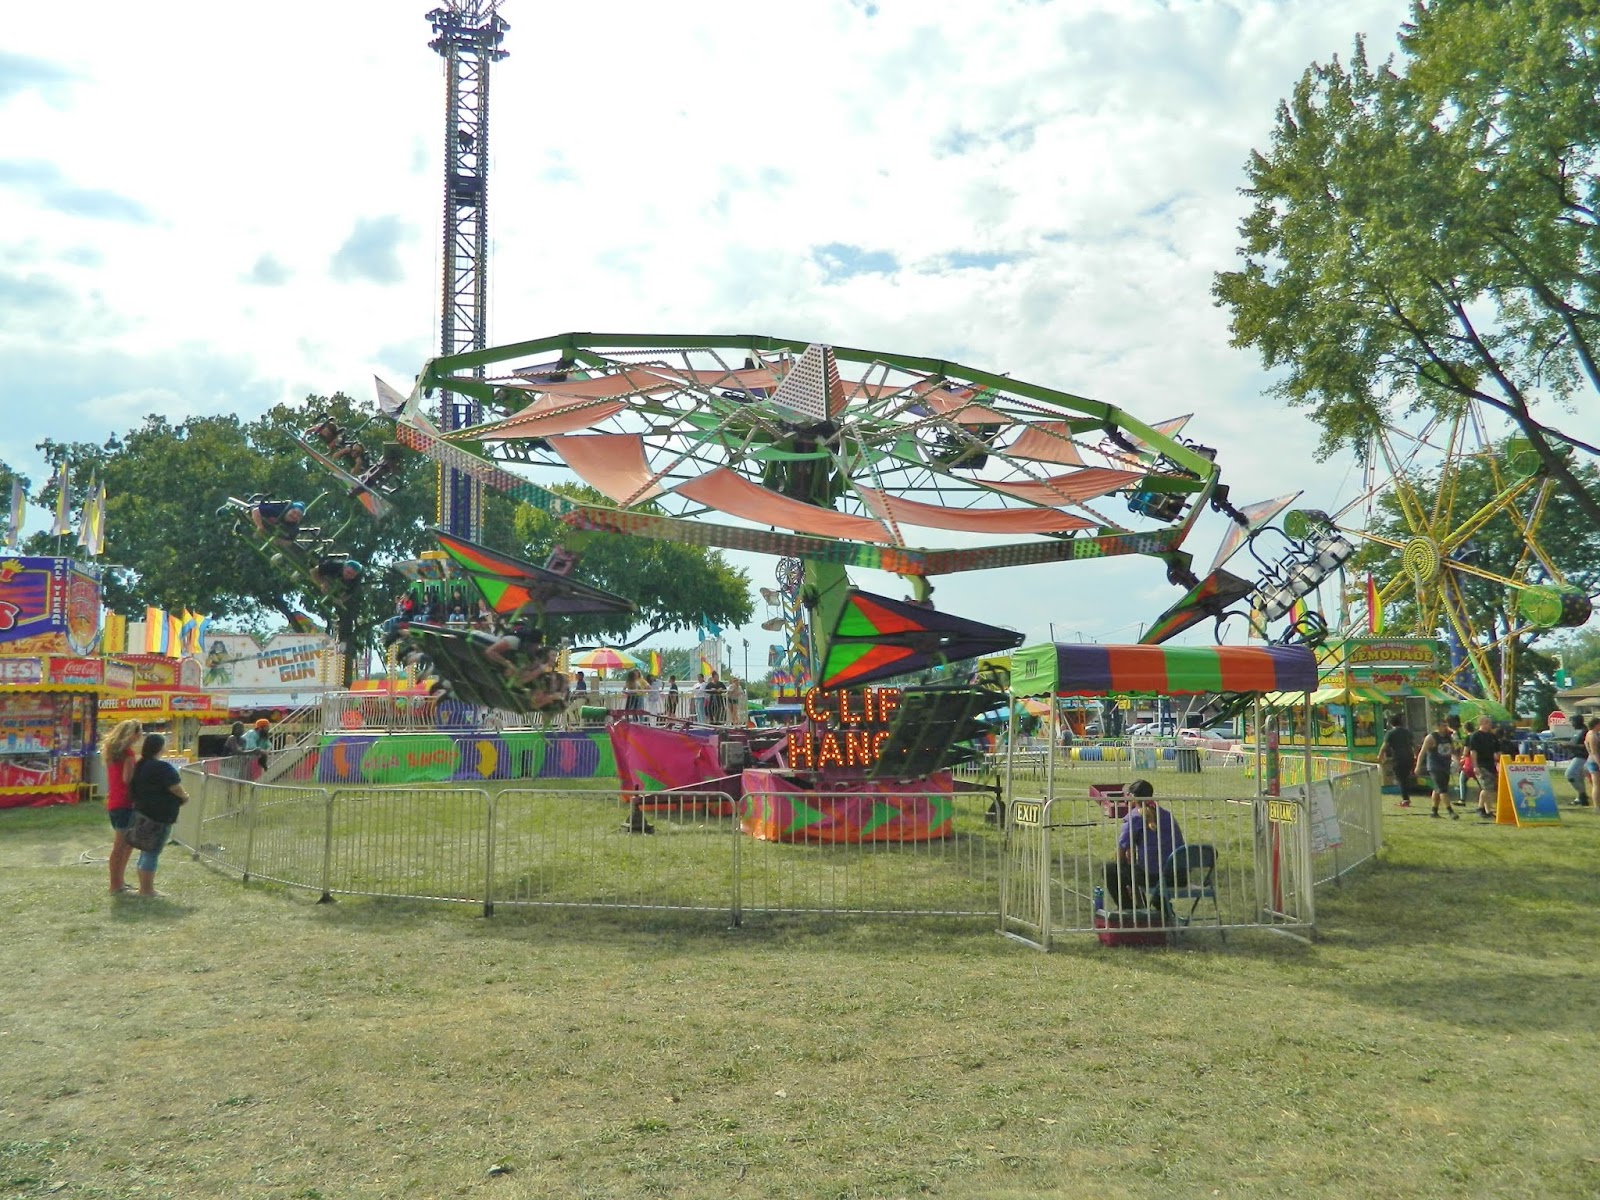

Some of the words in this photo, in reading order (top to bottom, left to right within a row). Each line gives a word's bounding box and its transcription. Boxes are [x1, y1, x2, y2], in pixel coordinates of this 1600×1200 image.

[256, 643, 324, 669] MACHIN
[1349, 649, 1435, 663] LEMONADE
[279, 661, 316, 682] GUN
[98, 698, 119, 709] COFFEE
[126, 698, 162, 709] CAPPUCCINO
[1549, 717, 1567, 726] STOP
[1017, 804, 1039, 822] EXIT
